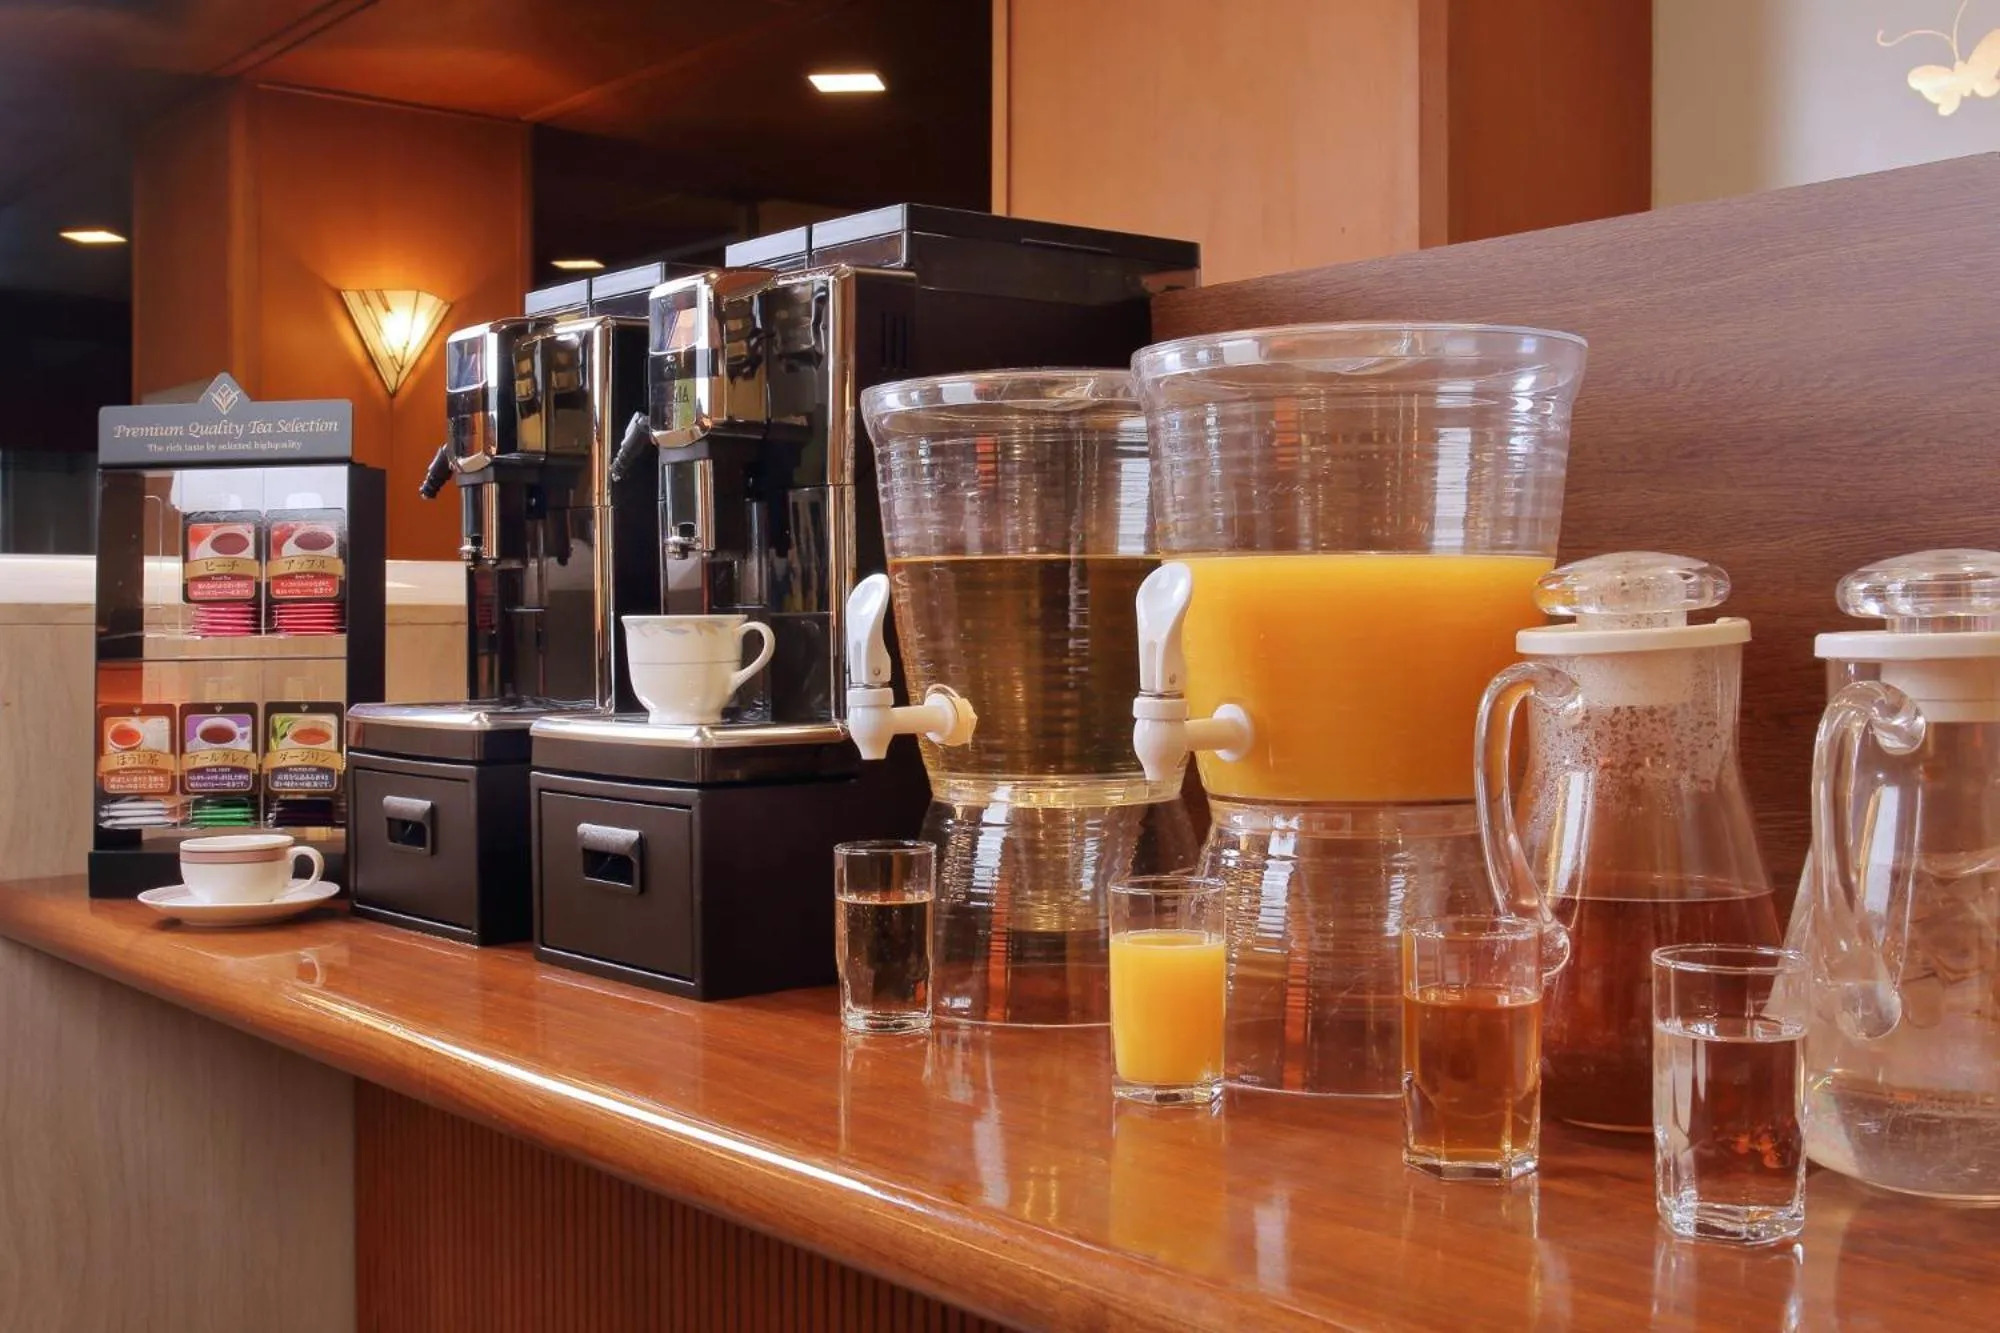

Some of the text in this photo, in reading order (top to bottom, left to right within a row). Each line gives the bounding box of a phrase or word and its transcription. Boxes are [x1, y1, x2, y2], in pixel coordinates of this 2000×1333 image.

[113, 418, 340, 440] Premium Quality Tea Selection
[146, 443, 162, 453] The
[166, 442, 181, 452] rich
[183, 441, 205, 452] taste
[206, 440, 216, 453] by
[189, 751, 249, 766] アールグレイ
